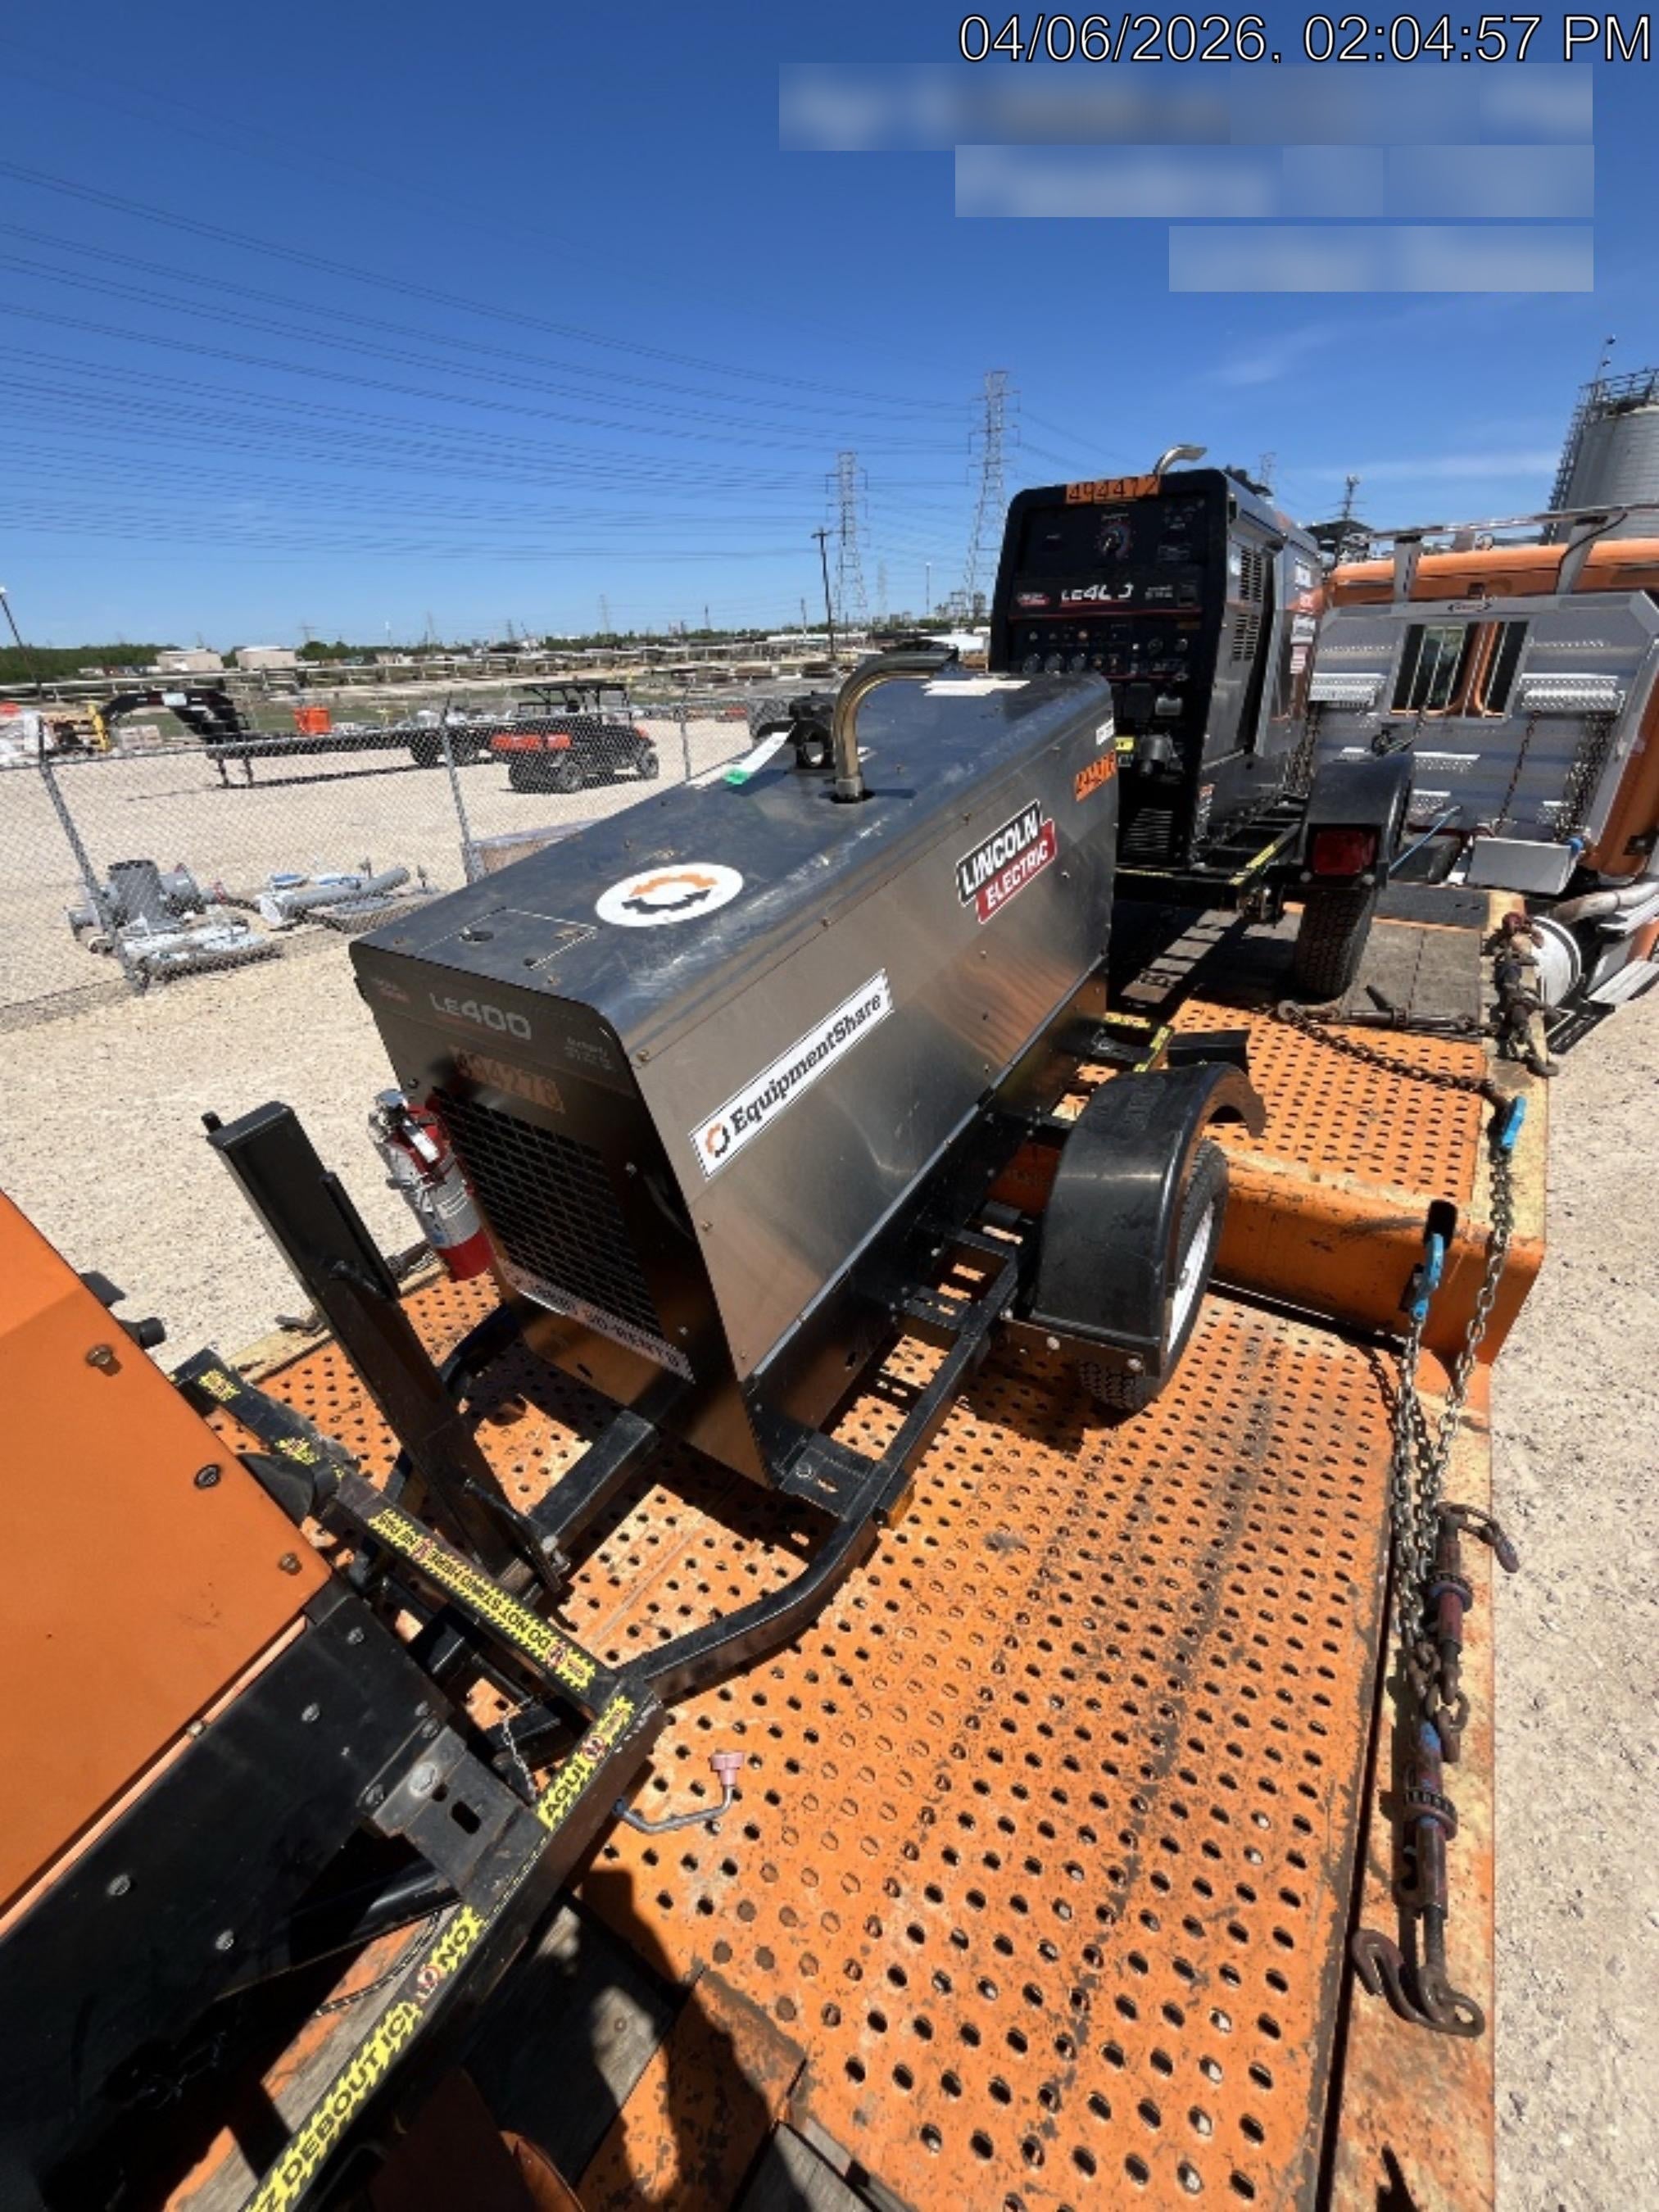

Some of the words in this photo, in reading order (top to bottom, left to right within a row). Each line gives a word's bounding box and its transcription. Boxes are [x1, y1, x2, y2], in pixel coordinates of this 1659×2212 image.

[962, 809, 1039, 895] LINCOLN
[985, 840, 1049, 910] ELECTRIC
[430, 993, 532, 1040] LE400
[730, 993, 882, 1135] EquipmentShare
[498, 1604, 530, 1632] NOT
[527, 1629, 551, 1649] DO
[437, 1924, 471, 1966] NO
[282, 2047, 380, 2187] DEBOUT
[380, 2004, 415, 2049] ICI
